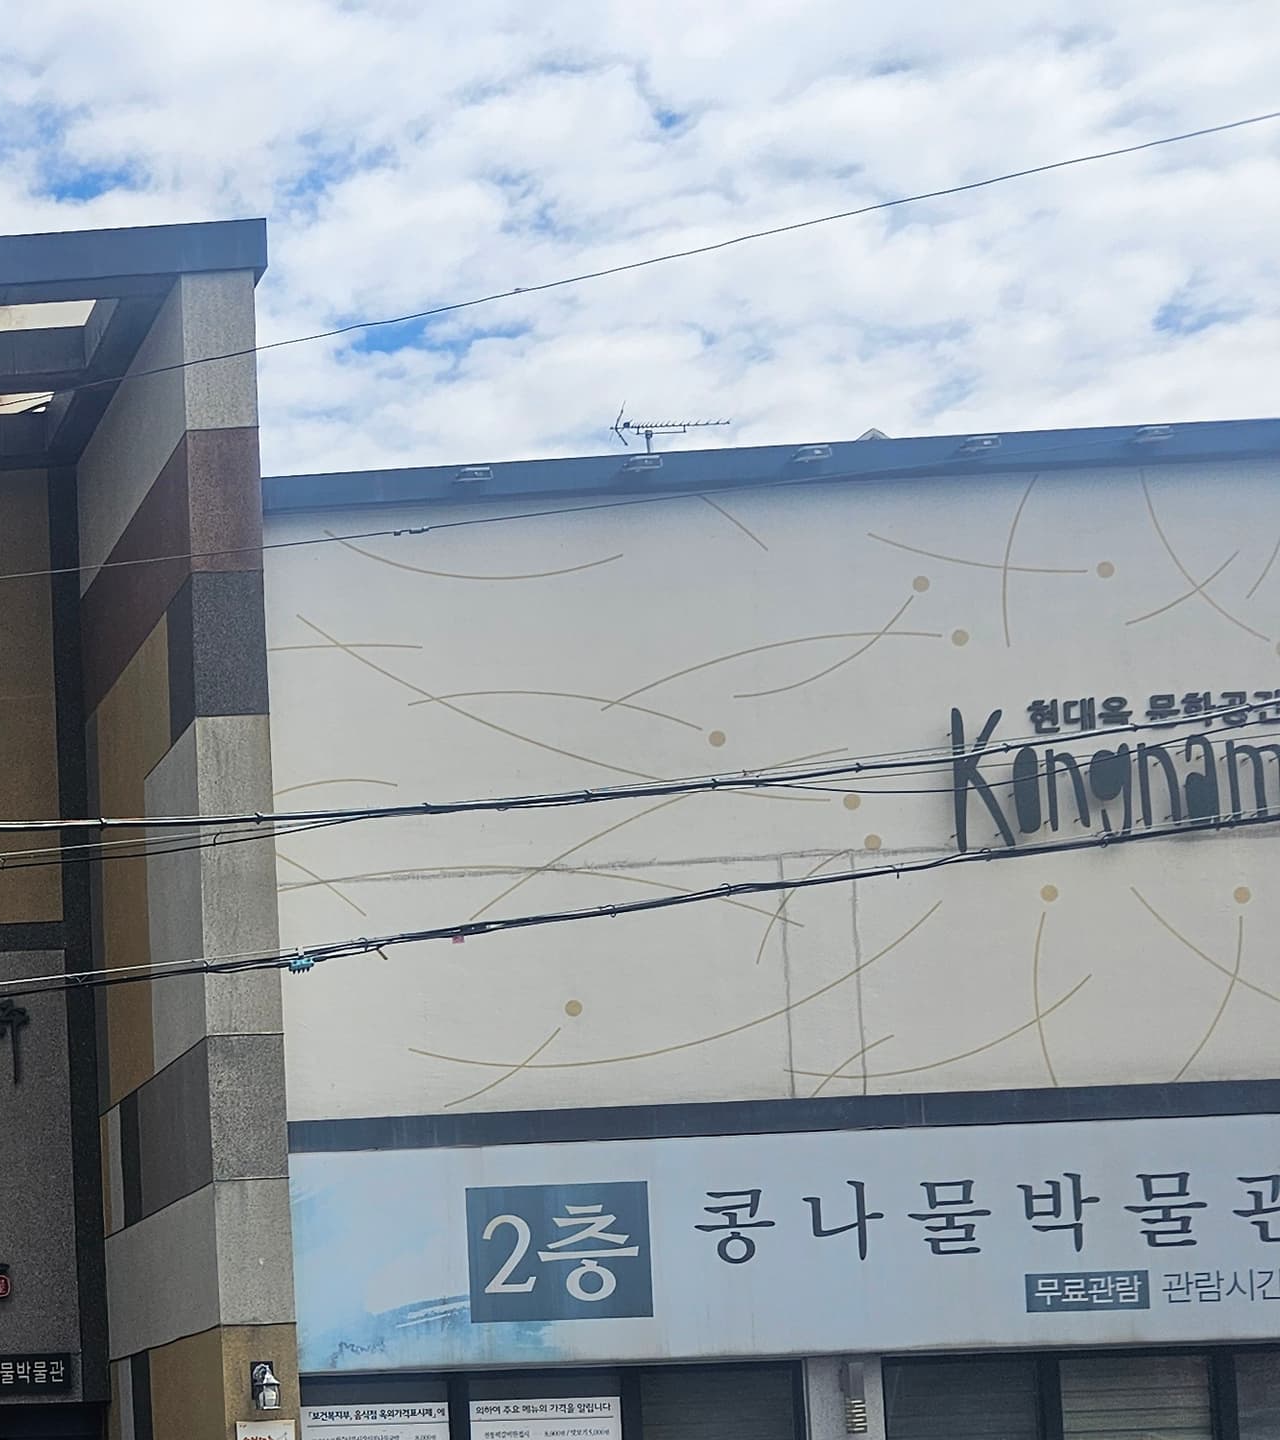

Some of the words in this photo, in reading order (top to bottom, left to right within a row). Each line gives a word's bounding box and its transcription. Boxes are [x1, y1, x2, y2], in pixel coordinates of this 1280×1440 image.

[1027, 696, 1132, 734] 현대옥
[481, 1202, 639, 1304] 2층
[1034, 1274, 1143, 1306] 무료관람
